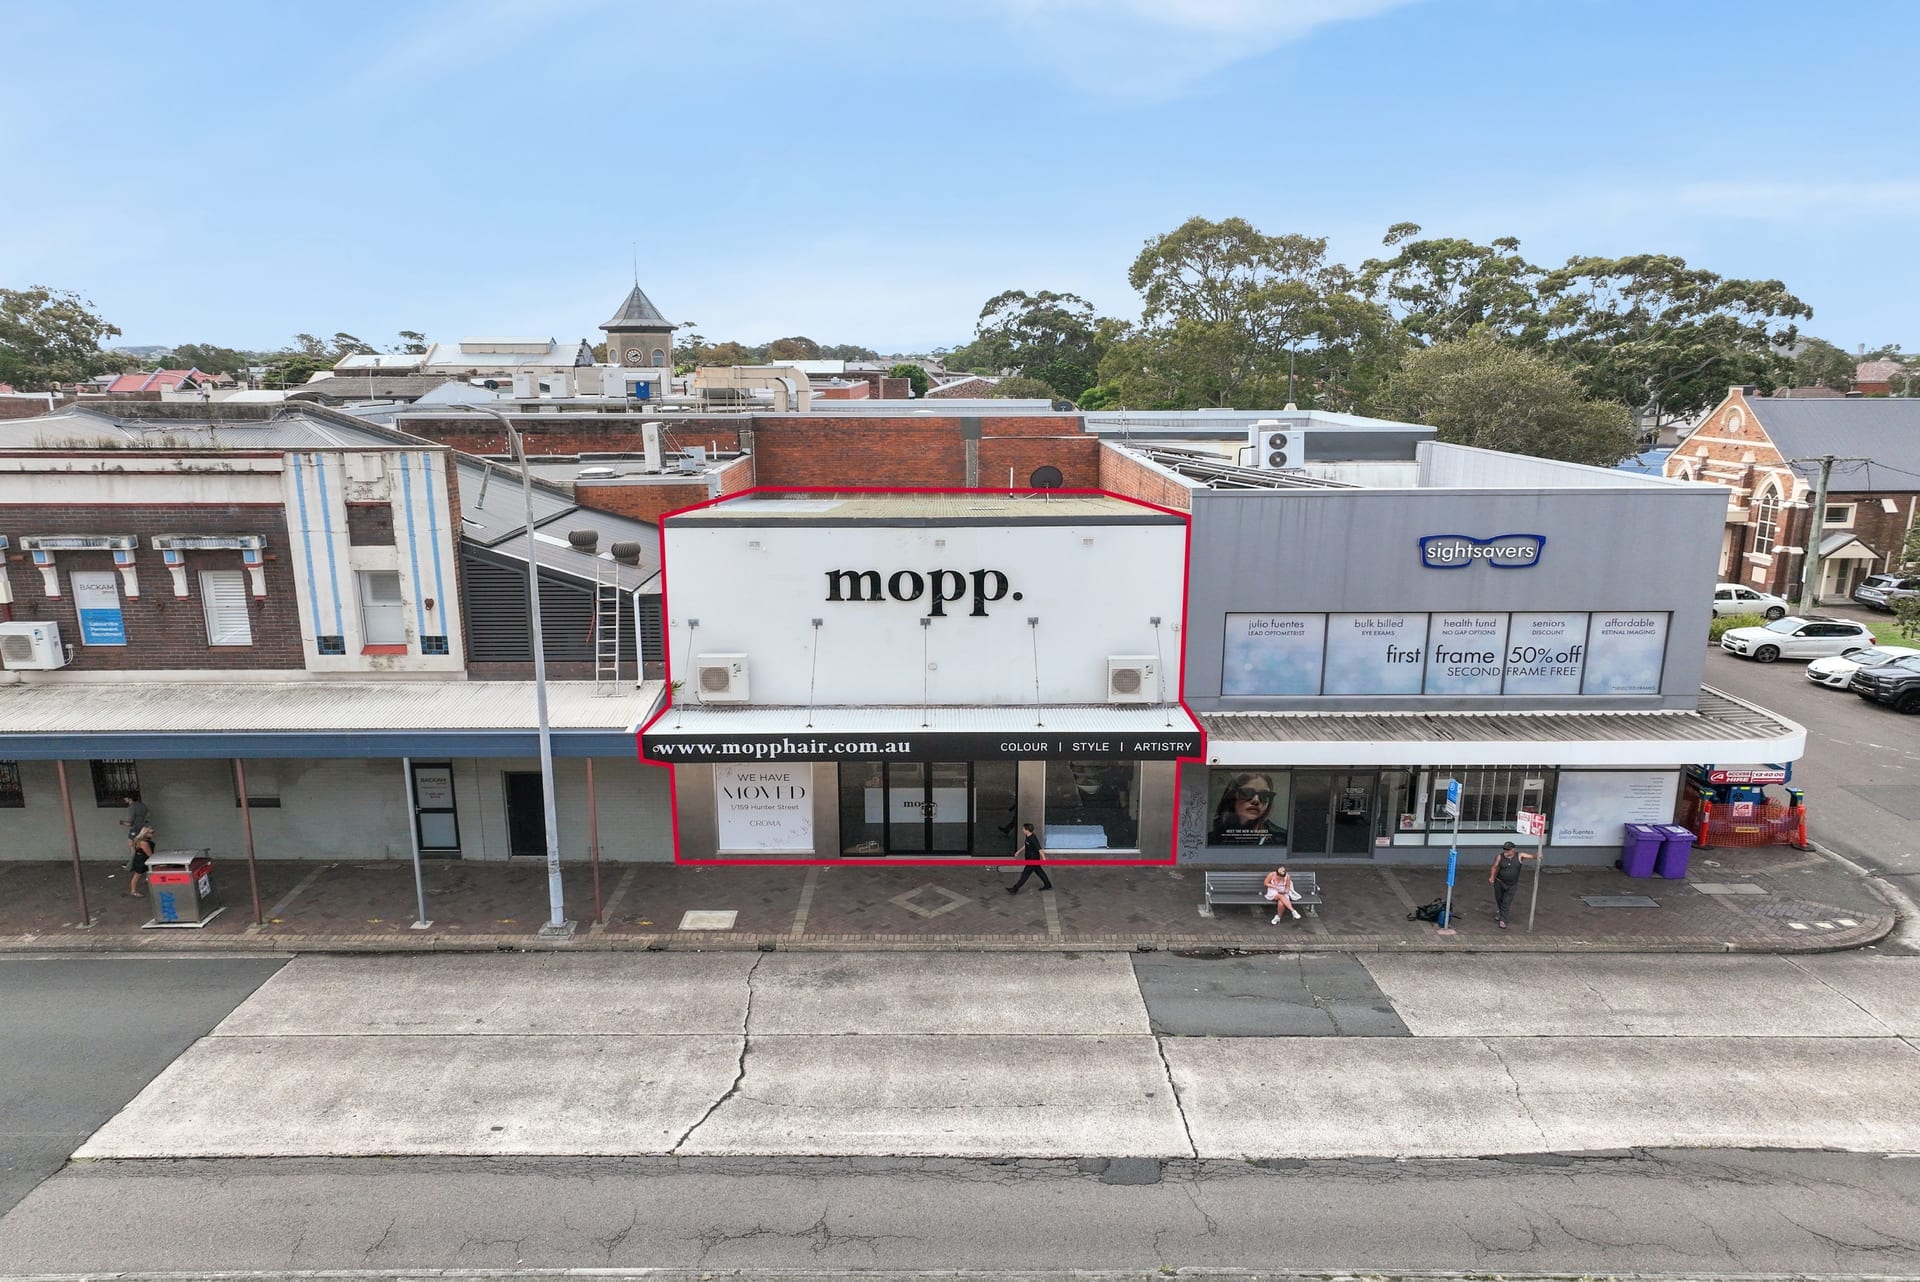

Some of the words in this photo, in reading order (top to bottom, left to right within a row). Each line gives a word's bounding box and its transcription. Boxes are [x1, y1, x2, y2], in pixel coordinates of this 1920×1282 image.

[1427, 541, 1535, 562] sightsavers
[825, 568, 1024, 617] mopp.
[1248, 619, 1269, 631] julio
[1271, 619, 1305, 629] fuentes
[1354, 619, 1375, 628] bulk
[1377, 619, 1404, 628] billed
[1443, 618, 1473, 628] health
[1475, 618, 1497, 628] fund
[1532, 619, 1566, 628] seniors
[1604, 618, 1655, 628] affordable
[1386, 644, 1421, 663] first
[1435, 644, 1495, 664] frame
[1447, 667, 1500, 677] SECOND
[1506, 667, 1547, 677] FRAME
[658, 738, 911, 759] www.mopphair.com.au
[1000, 742, 1048, 752] COLOUR
[1072, 742, 1110, 752] STYLE
[1134, 742, 1192, 752] ARTISTRY
[737, 773, 757, 782] WE
[759, 773, 791, 782] HAVE
[723, 785, 806, 800] MOVED
